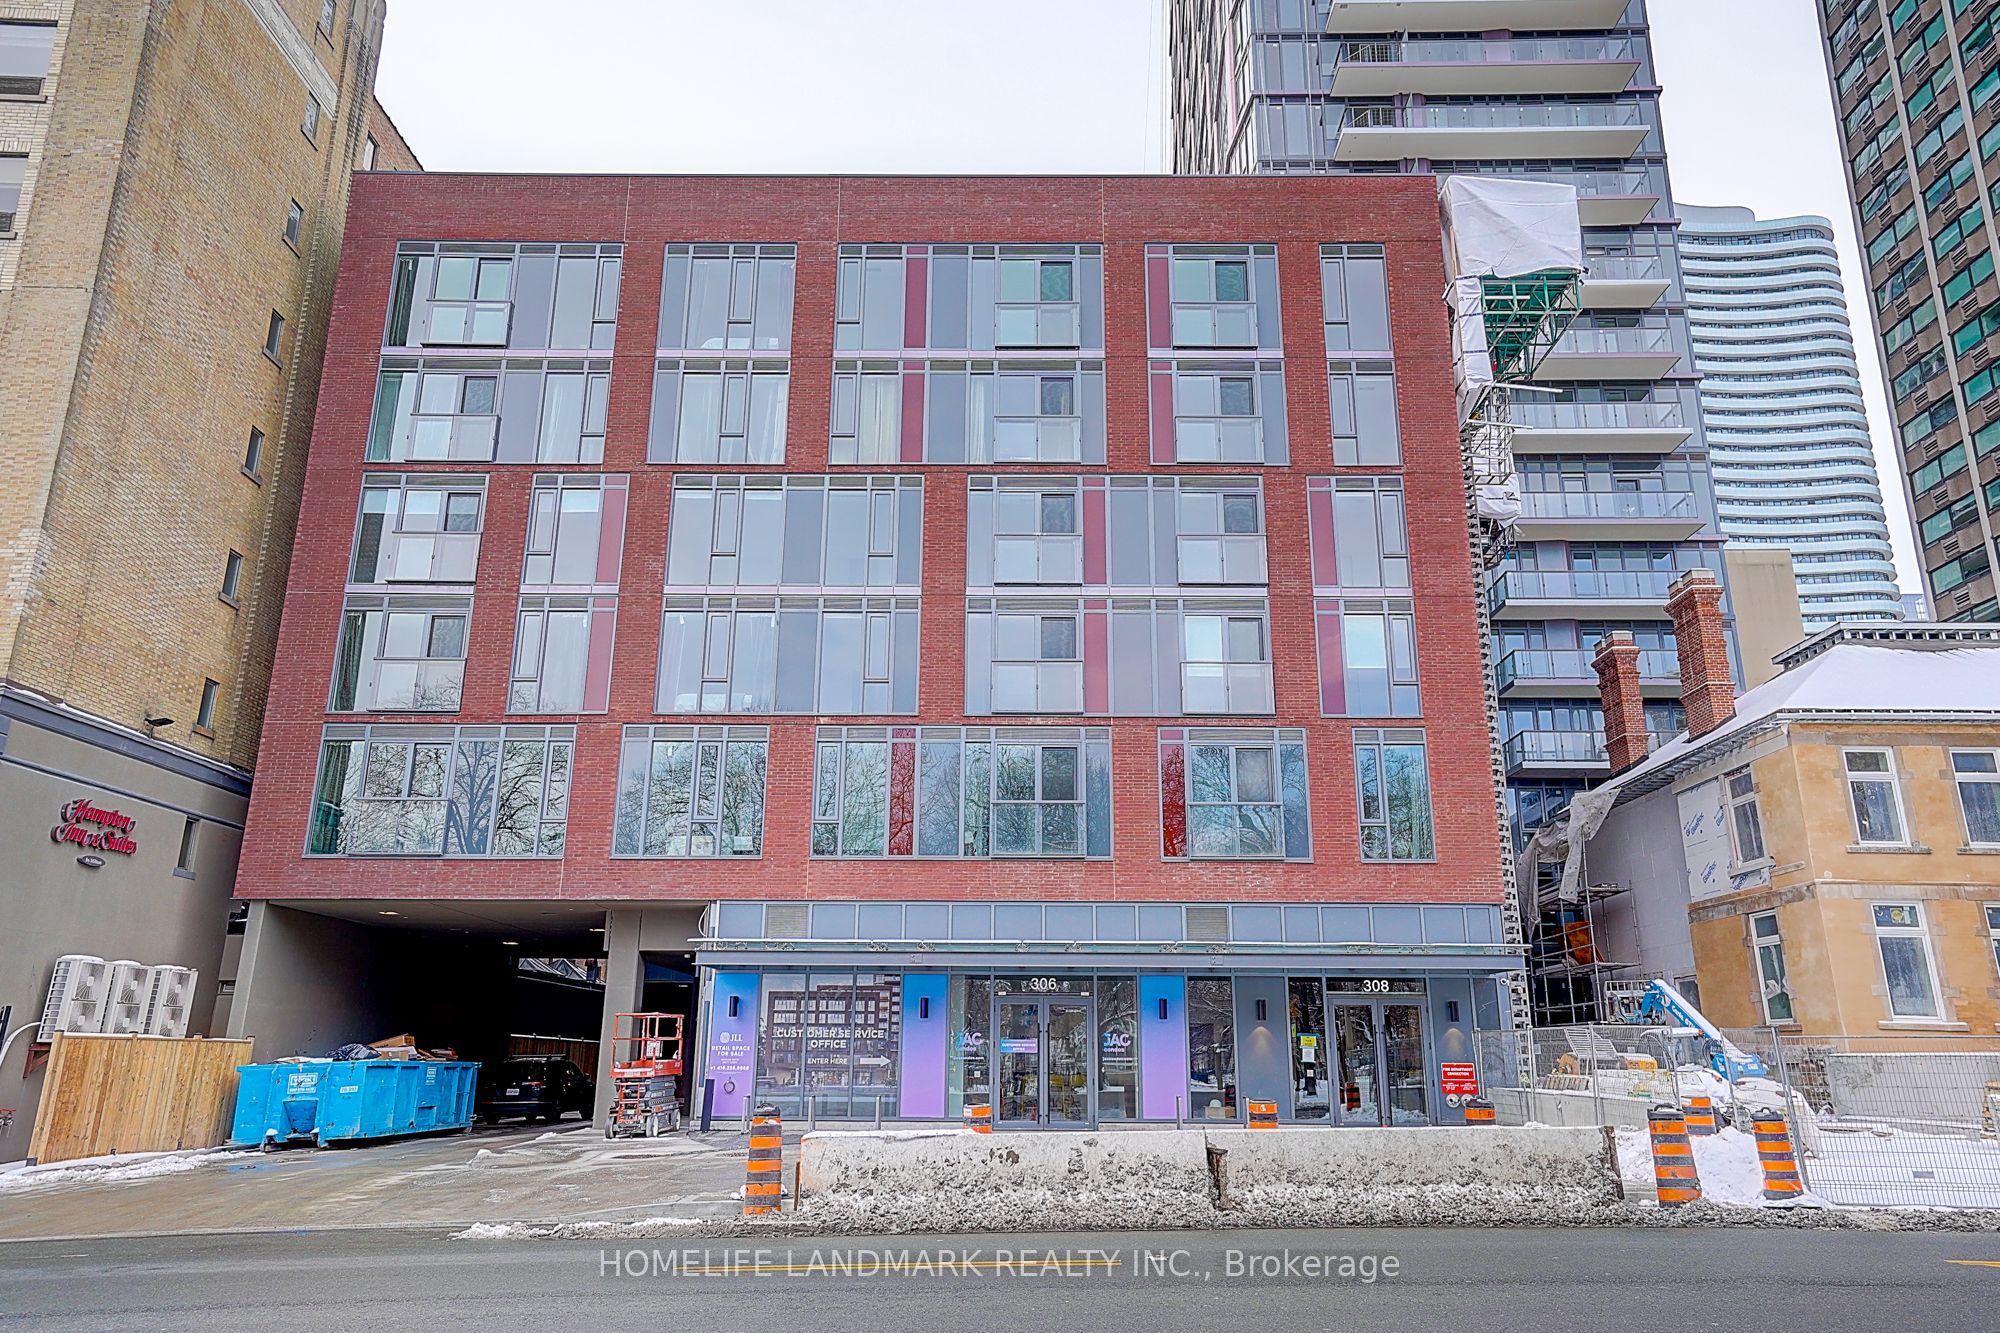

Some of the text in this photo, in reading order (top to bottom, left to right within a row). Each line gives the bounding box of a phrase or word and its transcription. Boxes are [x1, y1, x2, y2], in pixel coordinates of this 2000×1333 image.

[61, 799, 136, 834] Hampton
[51, 823, 93, 847] Inn
[101, 831, 137, 854] Suites
[1031, 977, 1057, 990] 306
[1363, 979, 1390, 992] 308
[730, 1033, 743, 1042] JLL
[777, 1029, 885, 1039] CUSTOMER SERVICE
[1103, 1032, 1132, 1047] JAC
[810, 1040, 847, 1049] OFFICE
